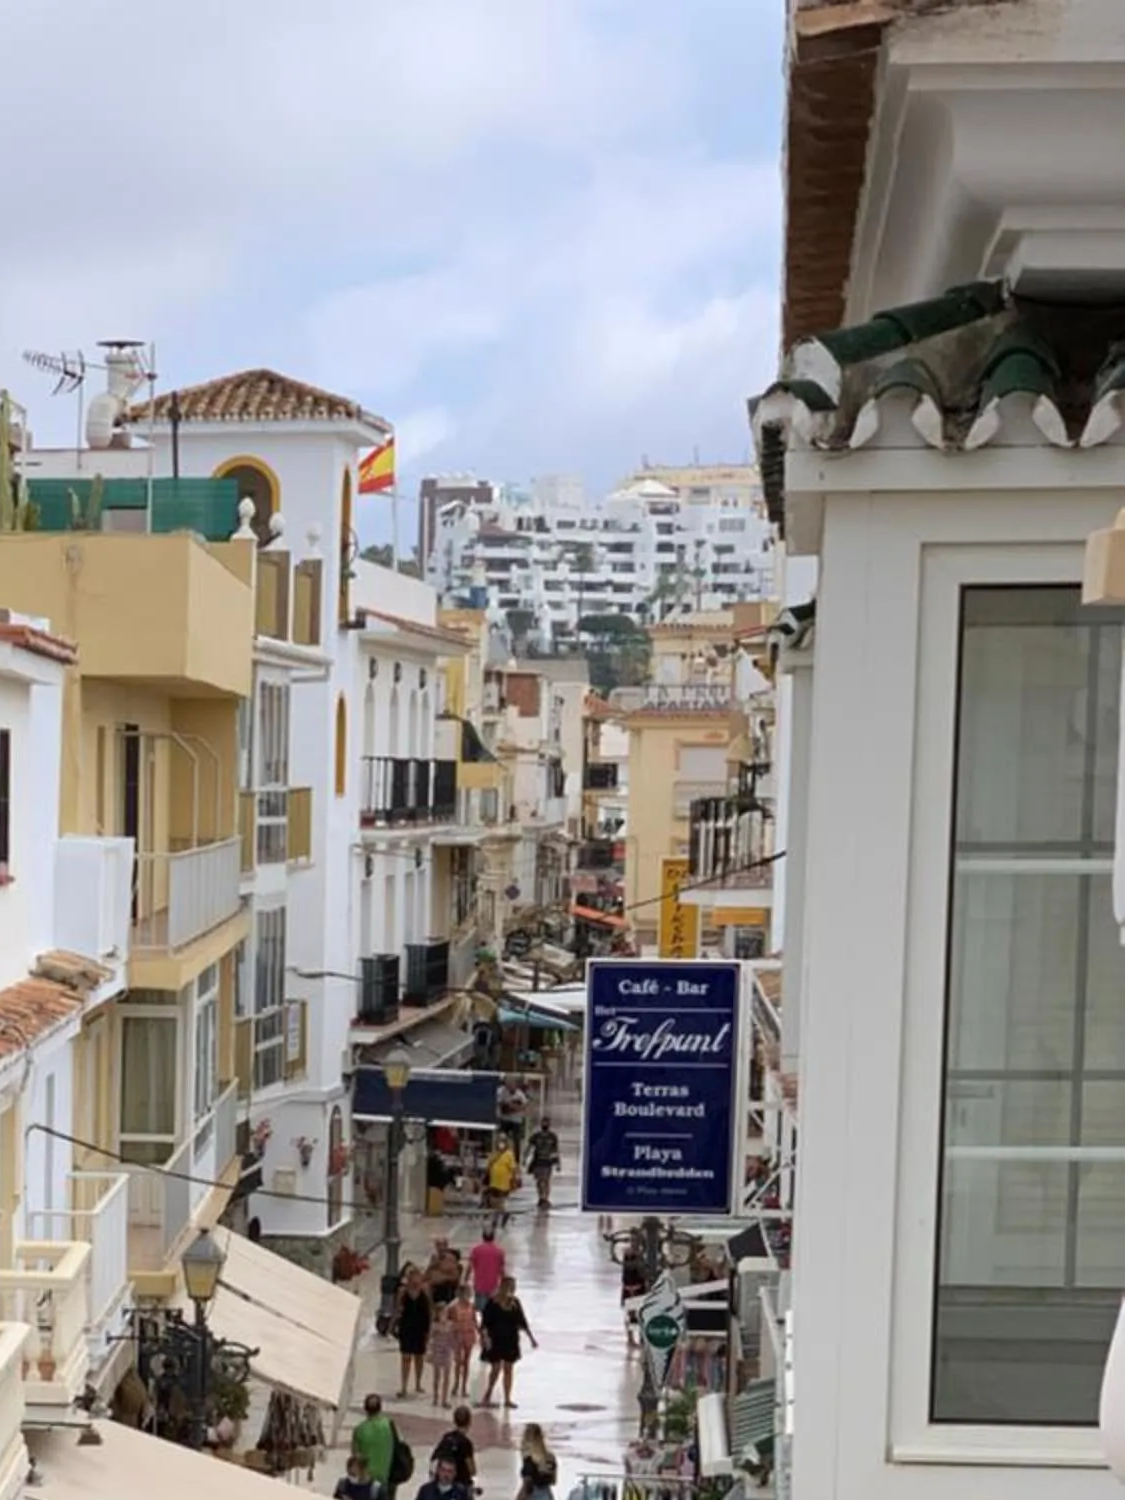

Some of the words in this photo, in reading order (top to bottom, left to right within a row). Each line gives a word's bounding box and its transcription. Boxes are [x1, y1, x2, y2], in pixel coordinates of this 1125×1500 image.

[618, 979, 660, 995] Café
[677, 981, 709, 995] Bar
[632, 1082, 689, 1097] Terras
[614, 1102, 705, 1117] Boulevard
[634, 1146, 683, 1165] Playa
